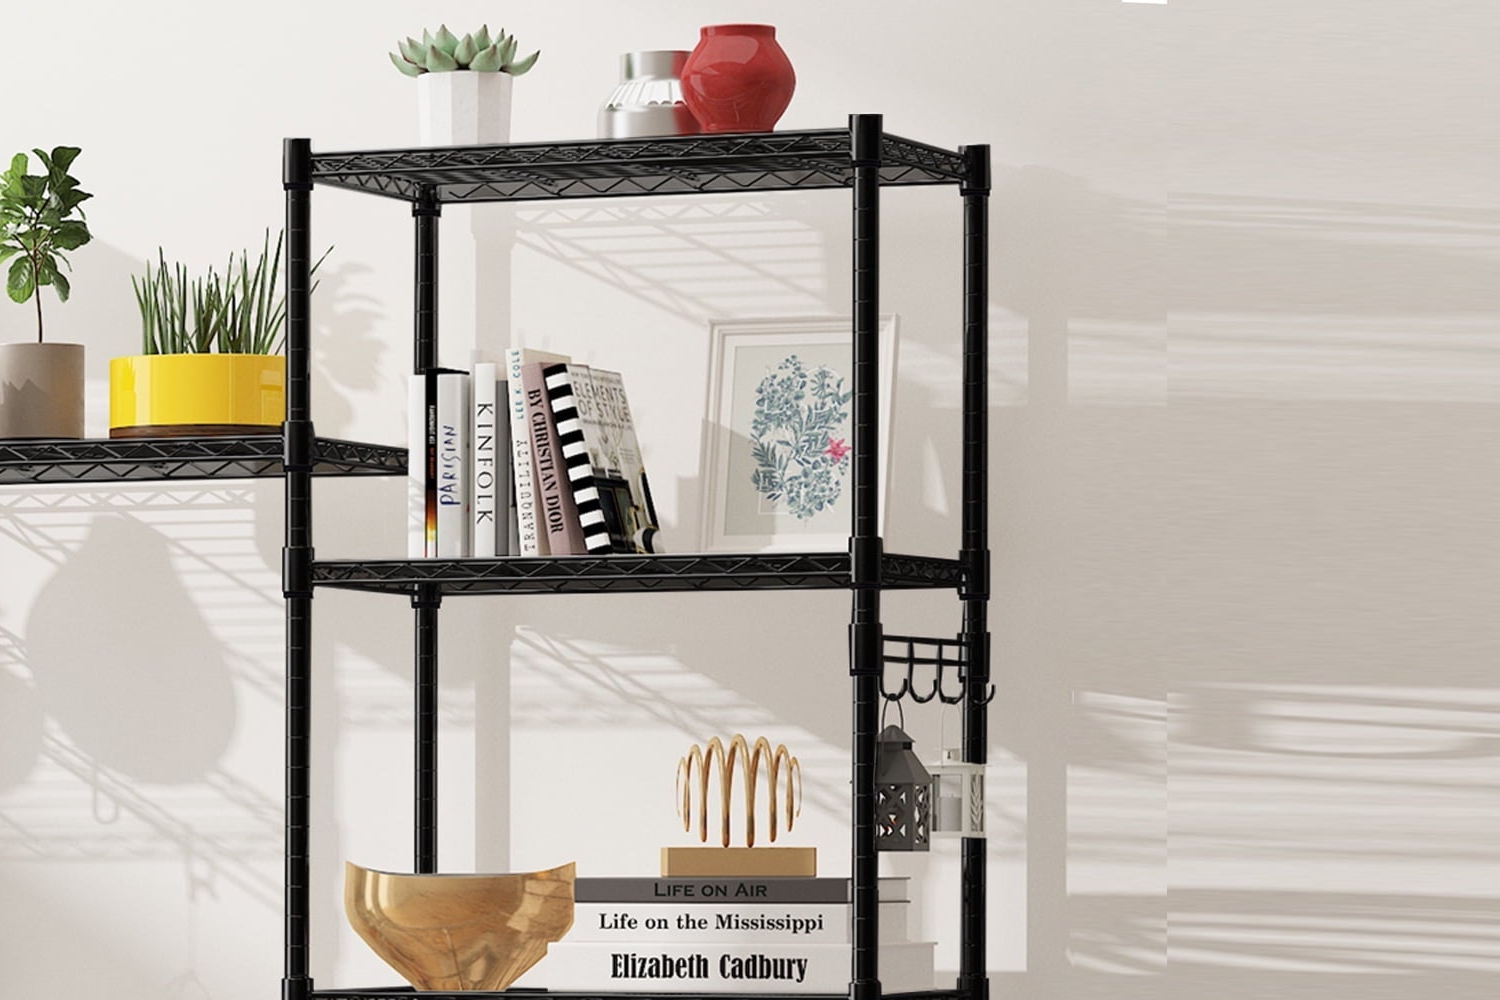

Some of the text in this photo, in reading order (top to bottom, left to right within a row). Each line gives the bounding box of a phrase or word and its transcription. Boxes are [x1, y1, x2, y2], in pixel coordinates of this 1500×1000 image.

[511, 350, 521, 379] COLE
[573, 380, 627, 405] ELEMENTS
[578, 399, 631, 423] OF STYLE
[439, 425, 461, 507] PARISIAN
[476, 403, 494, 524] KINFOLK
[527, 388, 565, 534] BY CHRISTIAN DIOR
[515, 439, 536, 552] TRANQUILITY
[599, 913, 823, 933] Life on the Mississippi
[611, 953, 808, 983] Elizabeth Cadbury
